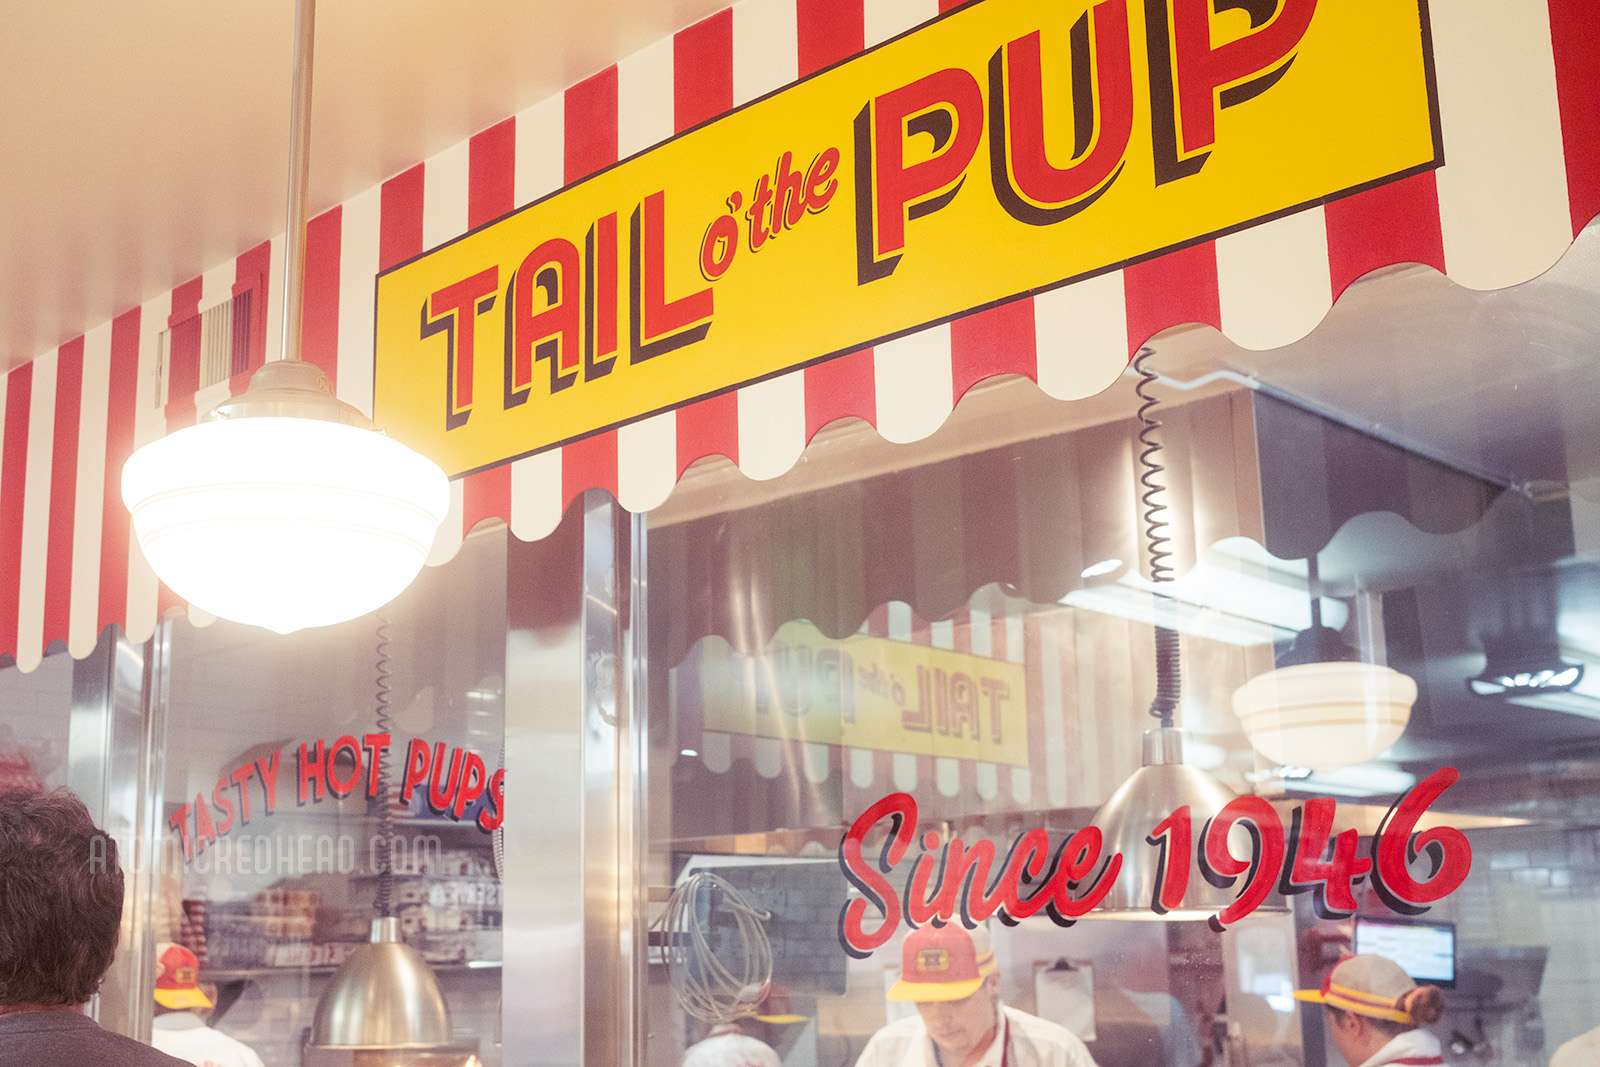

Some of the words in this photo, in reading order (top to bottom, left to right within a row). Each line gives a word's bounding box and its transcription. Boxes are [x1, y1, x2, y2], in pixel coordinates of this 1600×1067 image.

[420, 190, 714, 432] TAIL
[745, 147, 840, 253] the
[853, 0, 1318, 286] PUP
[168, 750, 281, 864] TASTY
[296, 733, 391, 806] HOT
[399, 738, 504, 833] PUPS
[838, 792, 1123, 960] Since
[1146, 766, 1473, 932] 1946
